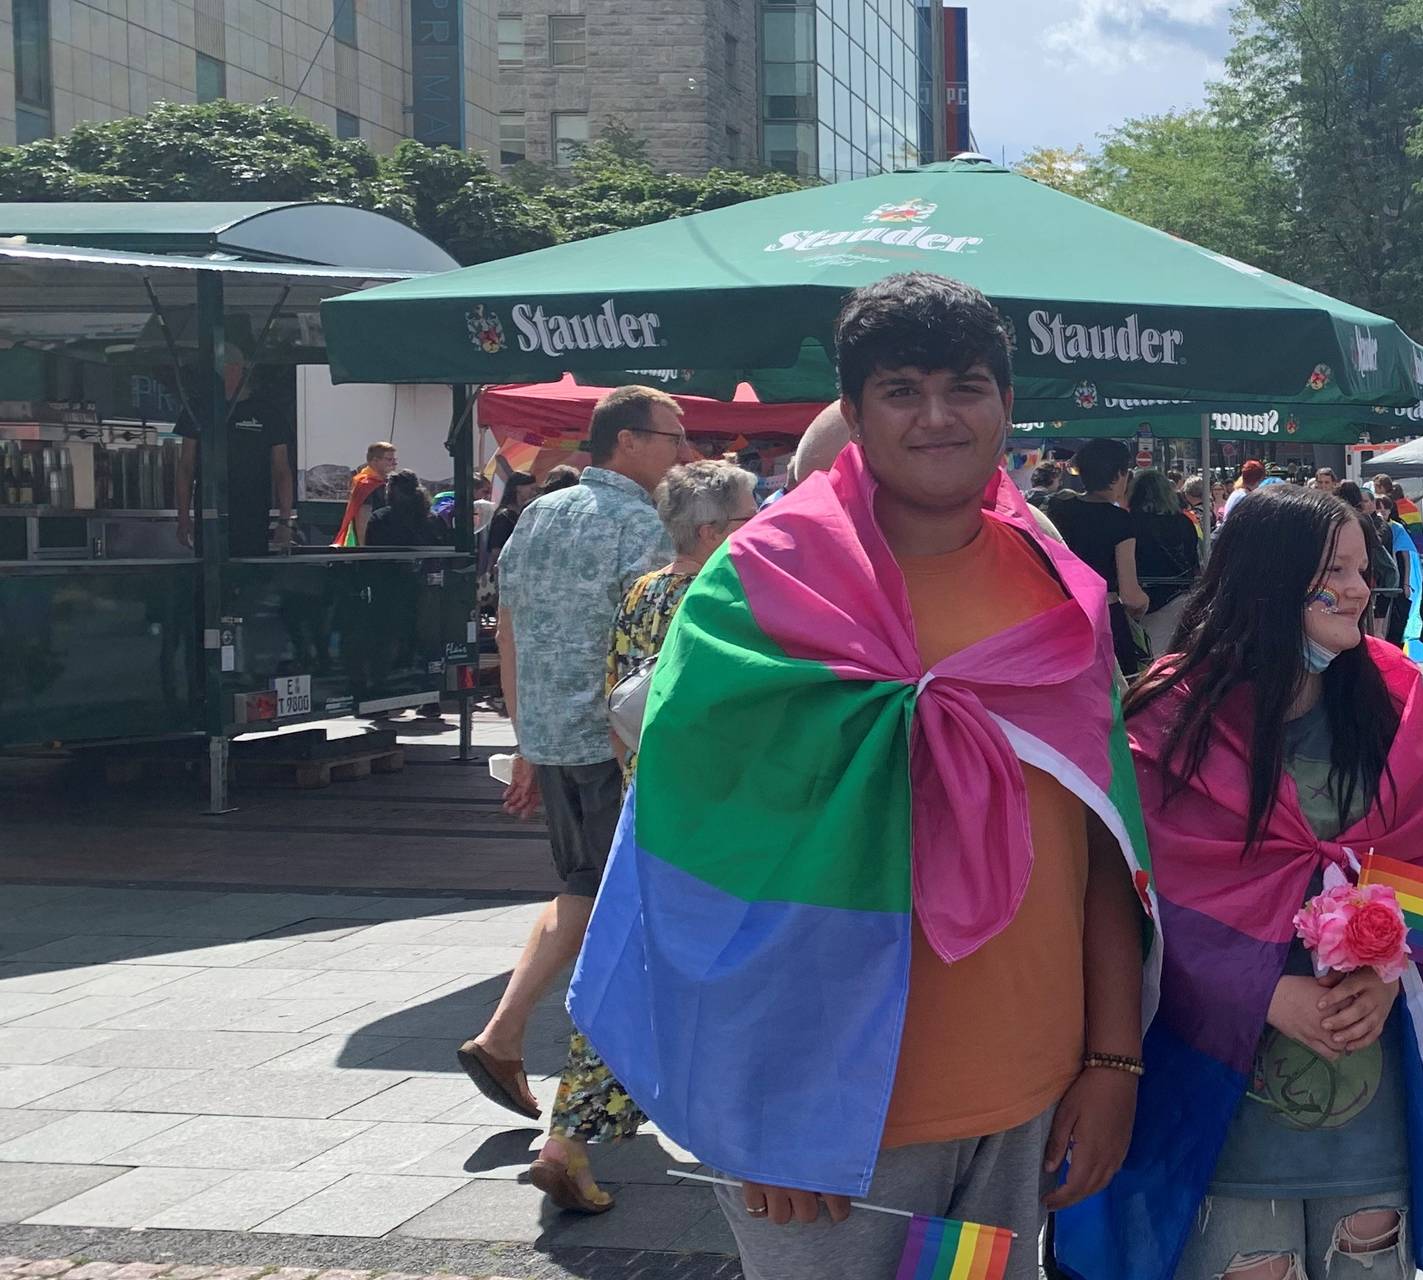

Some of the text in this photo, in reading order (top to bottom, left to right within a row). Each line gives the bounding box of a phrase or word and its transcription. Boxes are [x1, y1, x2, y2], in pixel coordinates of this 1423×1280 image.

[764, 226, 984, 254] Stauder
[511, 299, 661, 357] Stauder
[1028, 309, 1184, 365] Stauder
[287, 679, 293, 695] E
